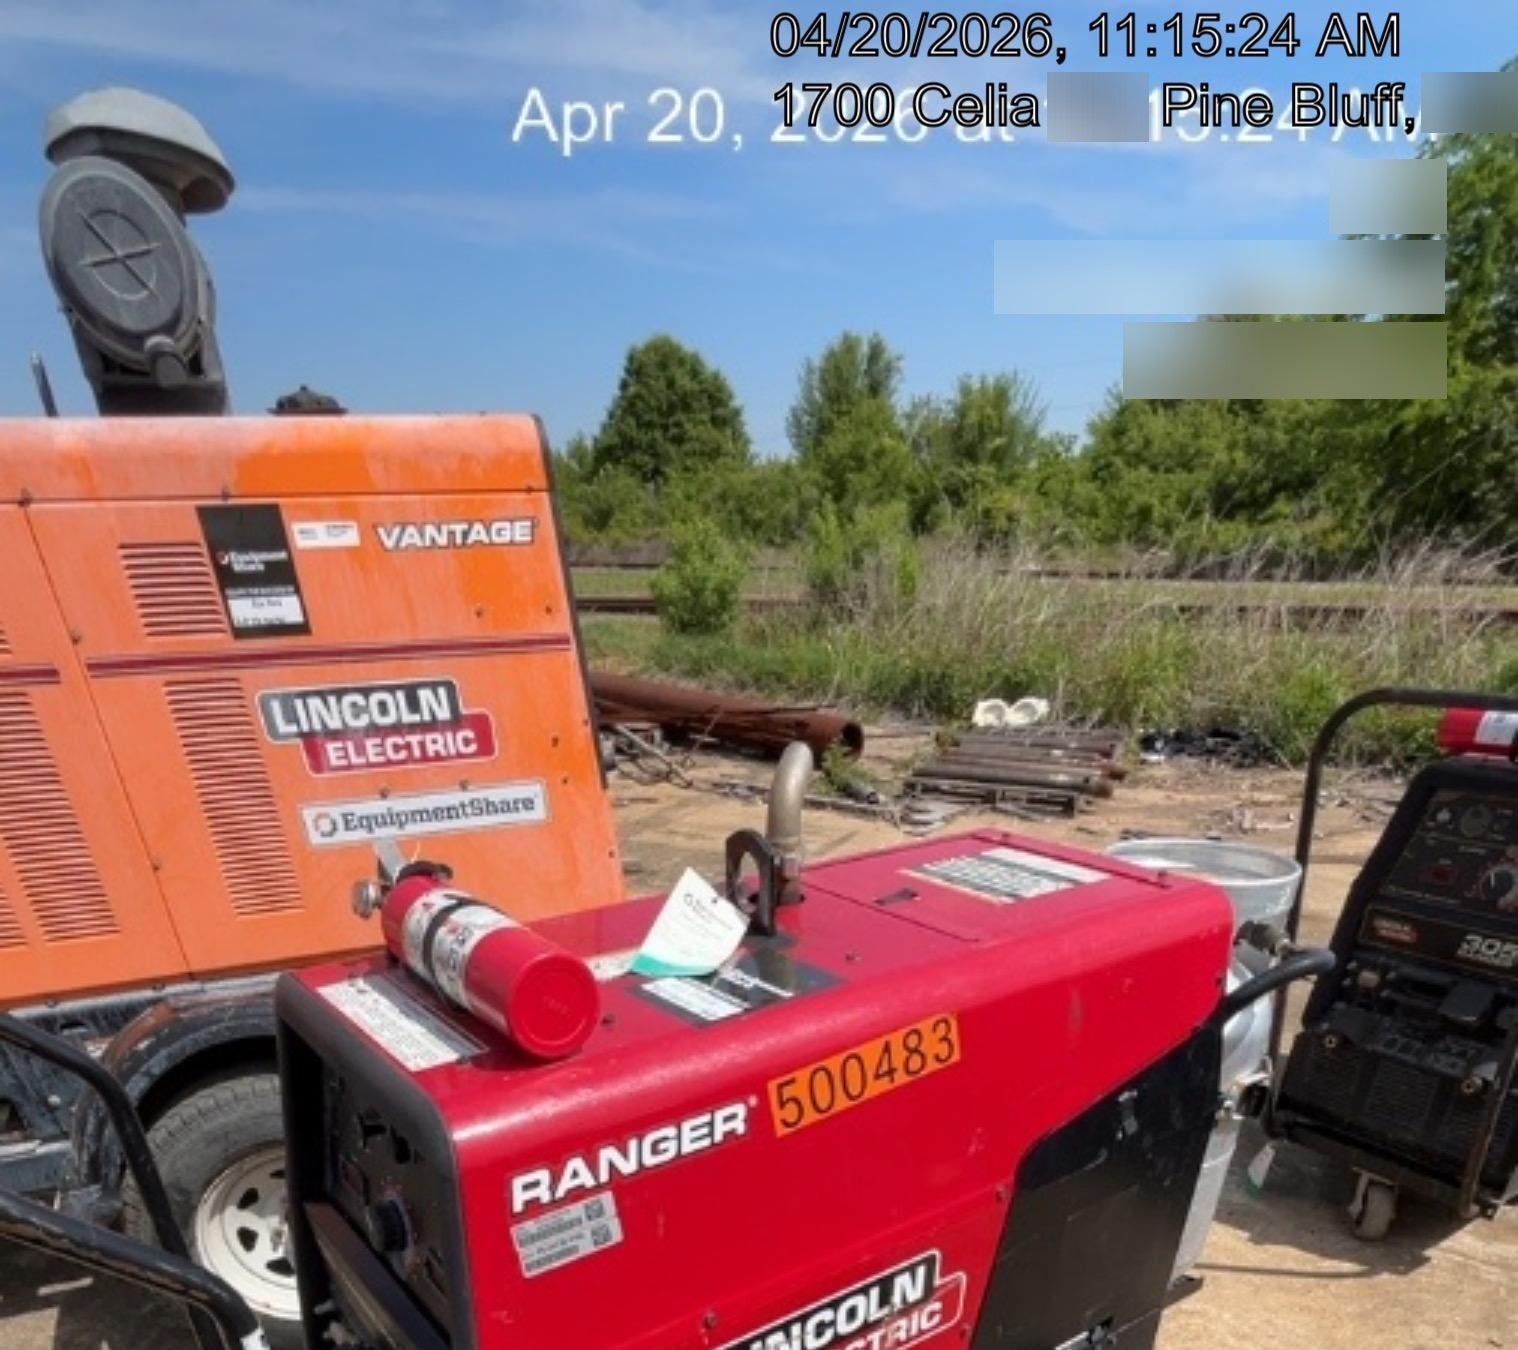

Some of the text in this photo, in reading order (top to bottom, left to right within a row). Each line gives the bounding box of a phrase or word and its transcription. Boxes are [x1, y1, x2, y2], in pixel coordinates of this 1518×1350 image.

[375, 519, 535, 550] VANTAGE
[268, 686, 452, 736] LINCOLN
[324, 728, 478, 769] ELECTRIC
[341, 794, 537, 835] EquipmentShare
[774, 1017, 957, 1129] 500483
[510, 1102, 749, 1214] RANGER
